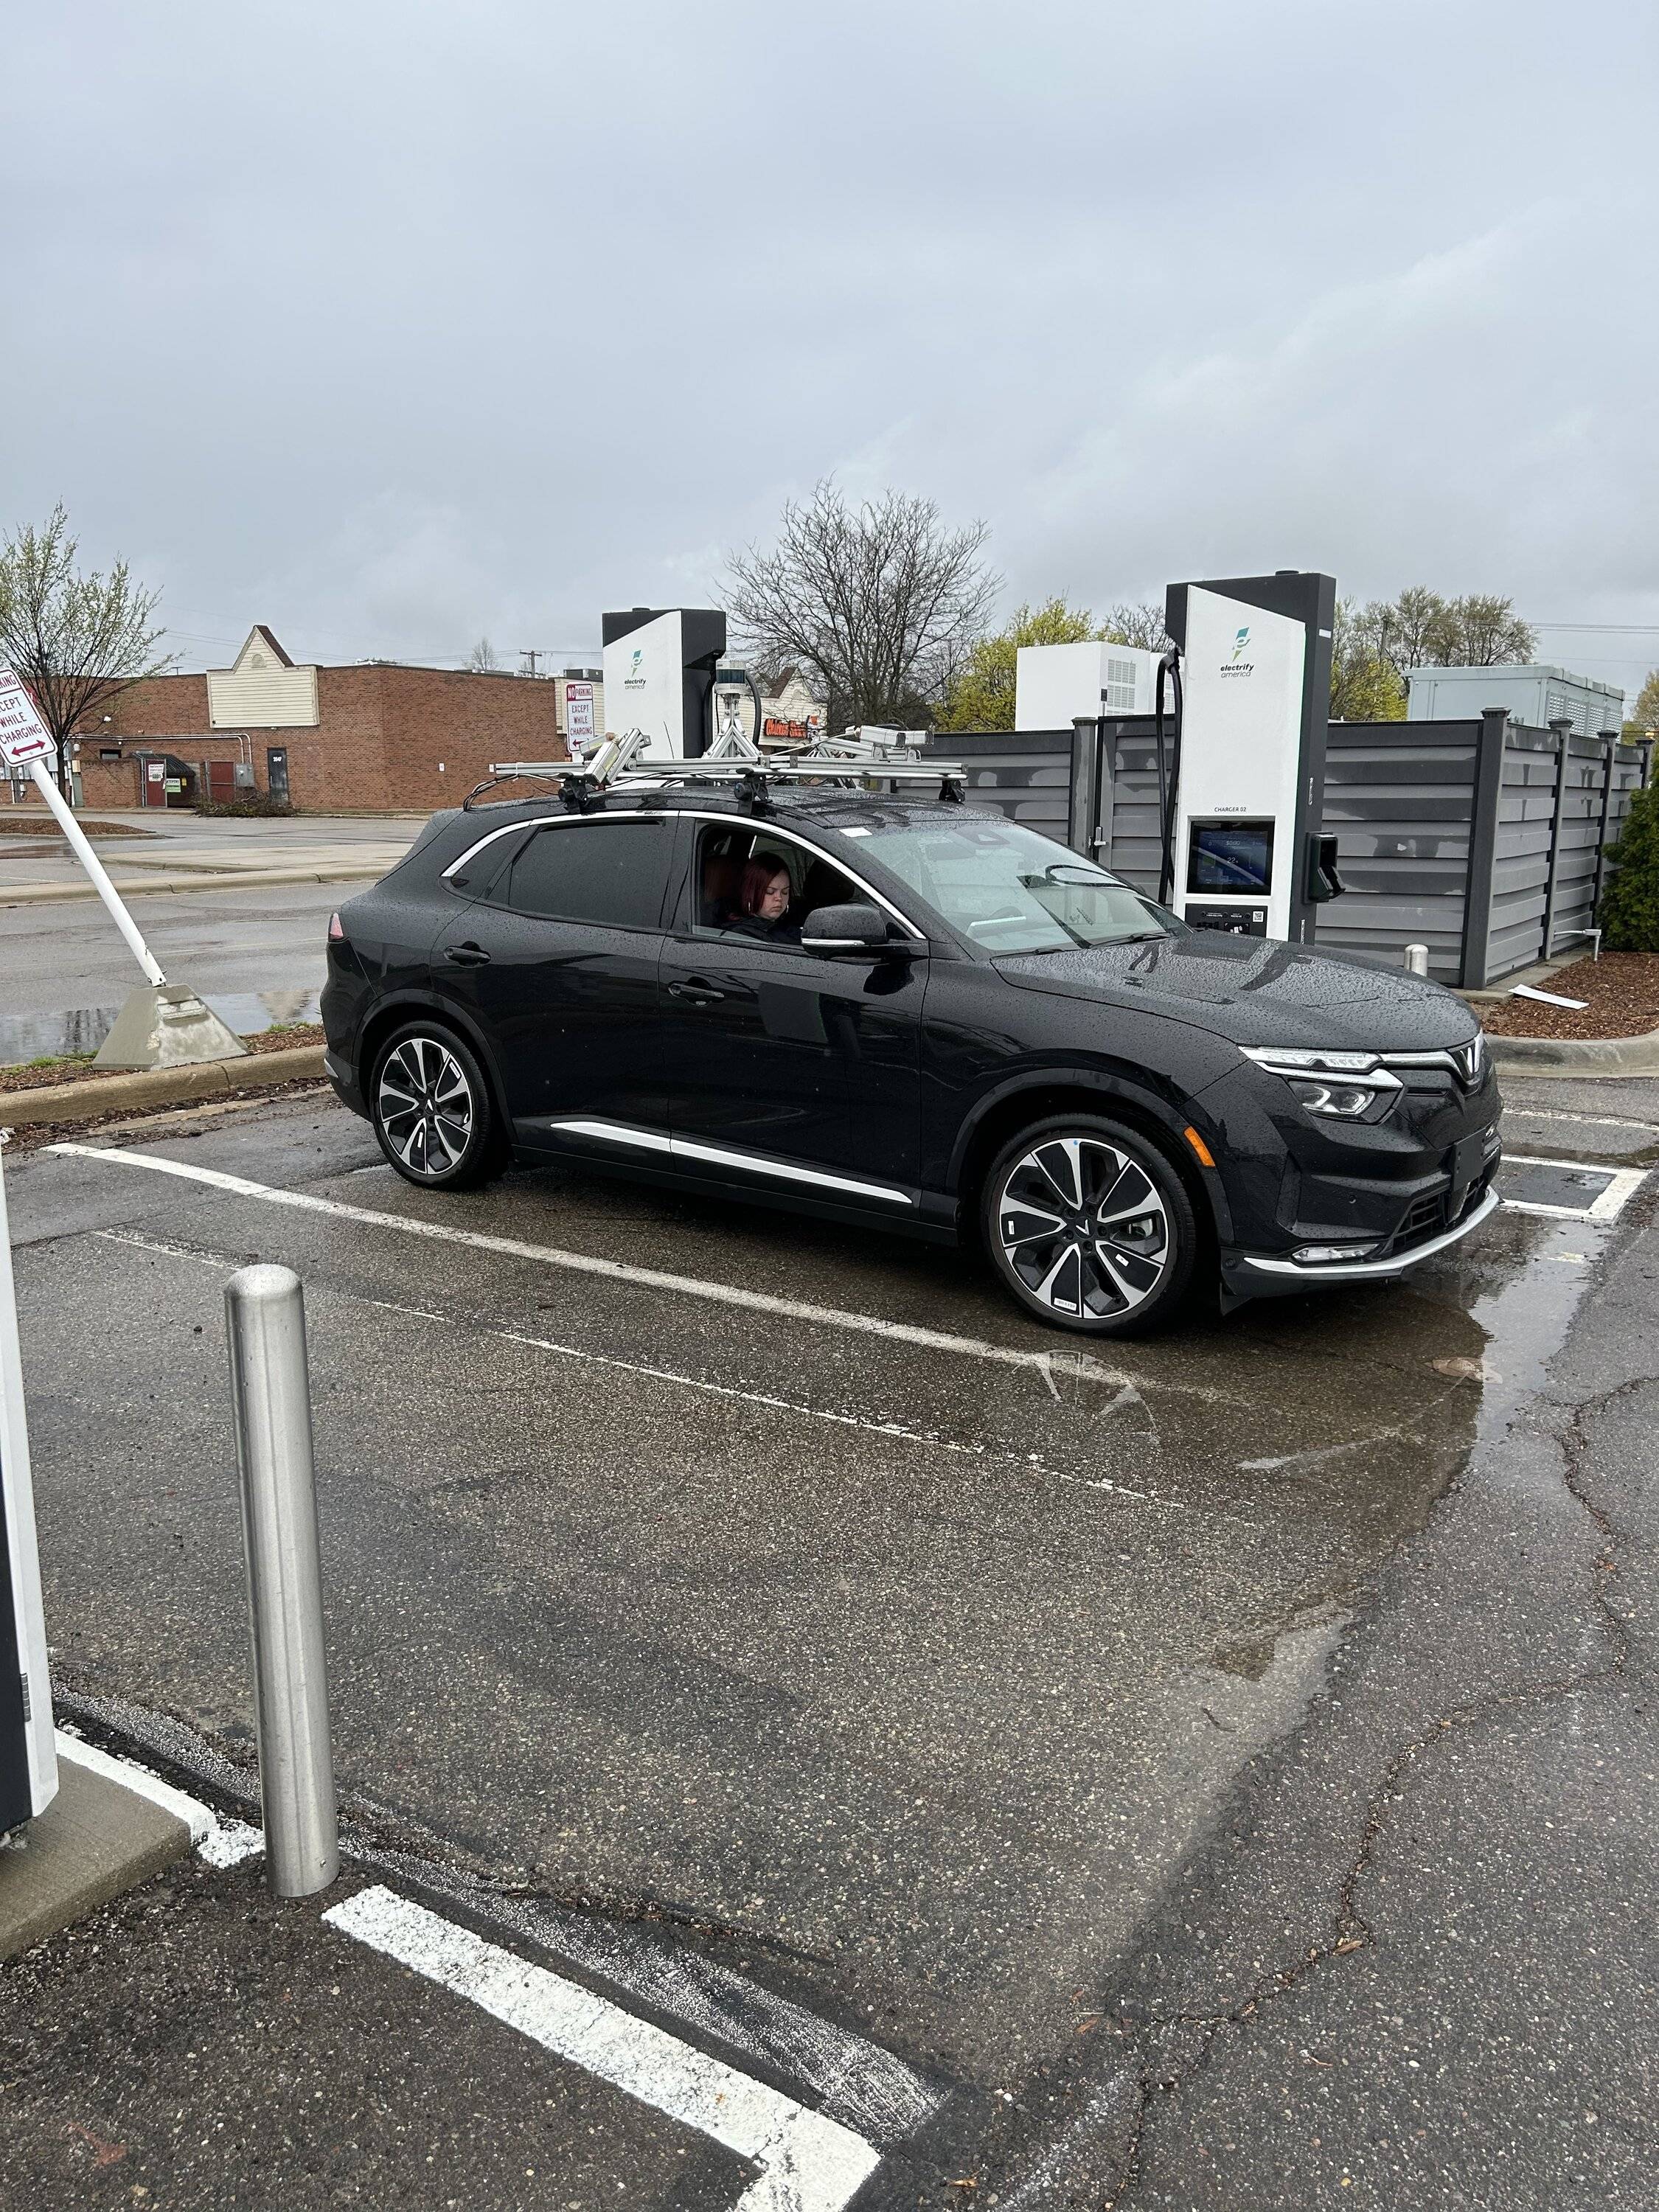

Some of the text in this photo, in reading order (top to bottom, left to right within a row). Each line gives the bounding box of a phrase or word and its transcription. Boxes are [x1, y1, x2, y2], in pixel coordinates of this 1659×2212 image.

[0, 675, 16, 689] KING
[568, 687, 591, 699] NO PARKING
[0, 697, 21, 712] CEPT
[572, 704, 589, 713] EXCEPT
[0, 712, 27, 728] WHILE
[0, 724, 42, 745] CHARGING
[570, 727, 593, 736] CHARGING
